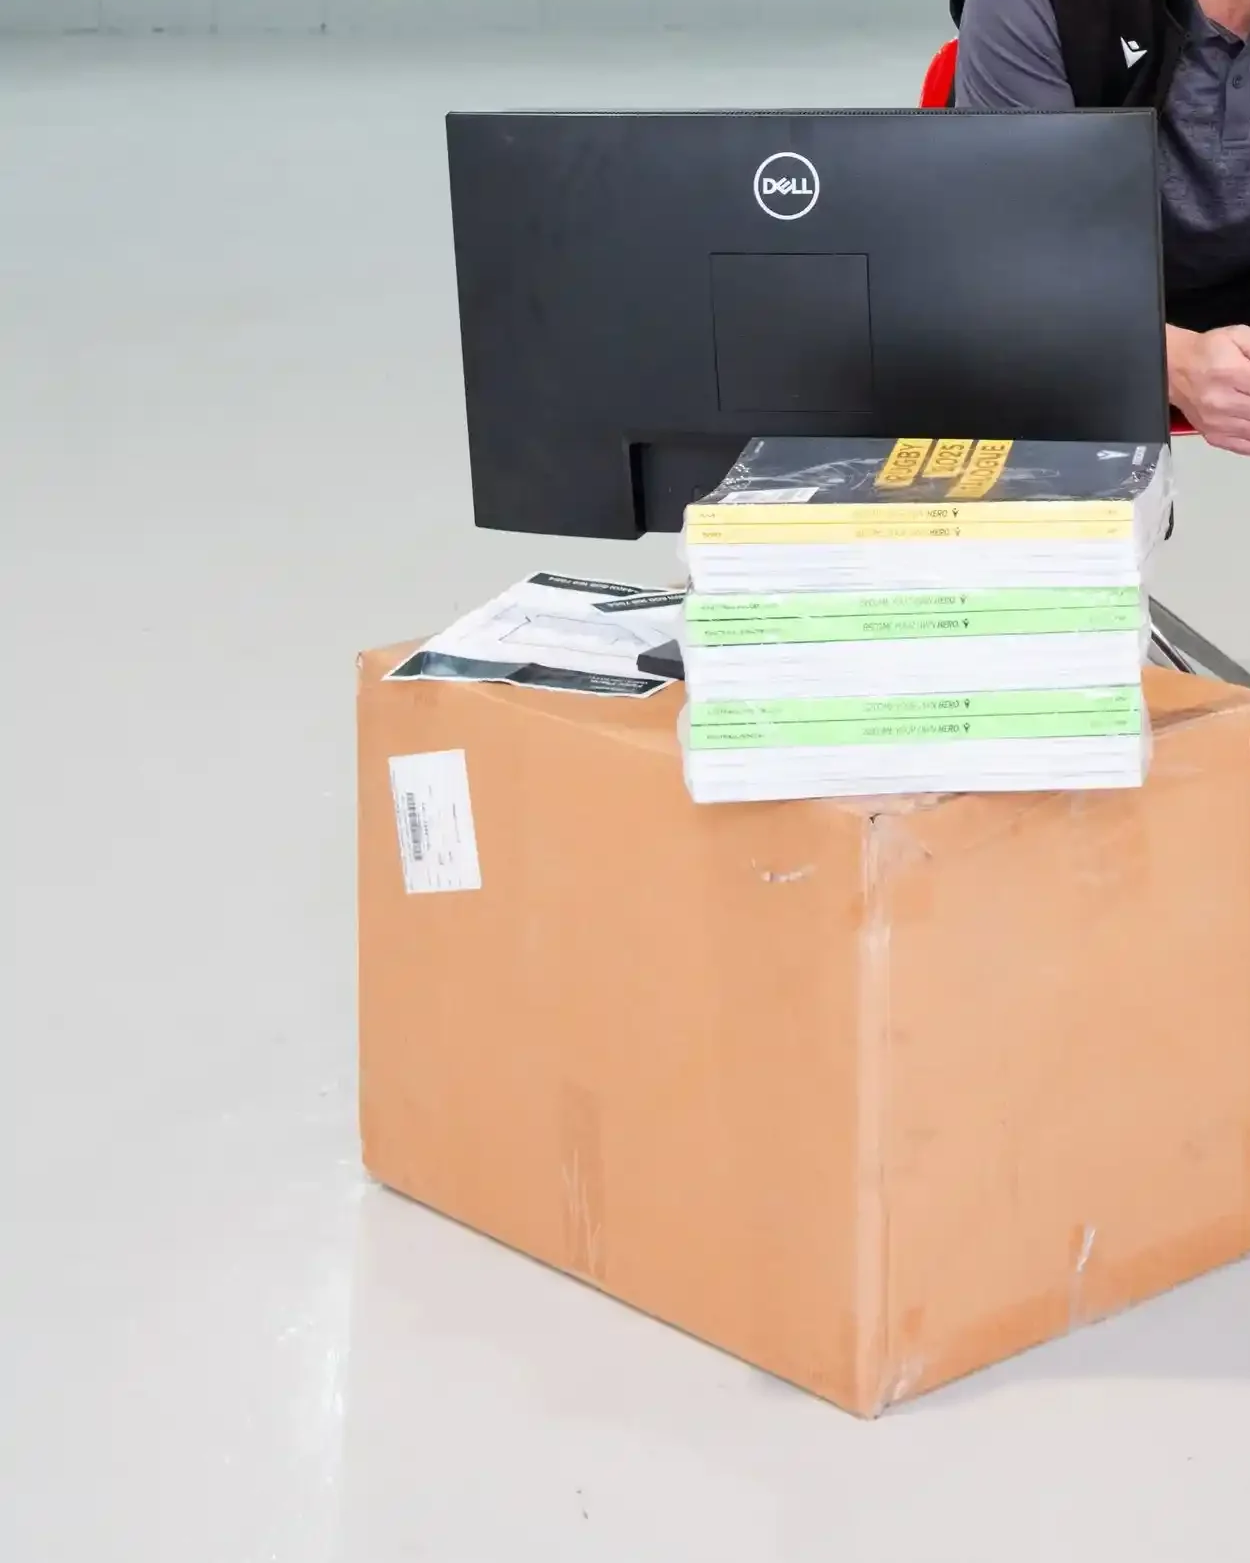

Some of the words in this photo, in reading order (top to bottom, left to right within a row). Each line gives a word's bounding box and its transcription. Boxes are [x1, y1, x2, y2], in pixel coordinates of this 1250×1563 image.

[762, 177, 814, 196] DELL
[886, 442, 924, 482] RUGBY
[932, 443, 965, 474] 2025
